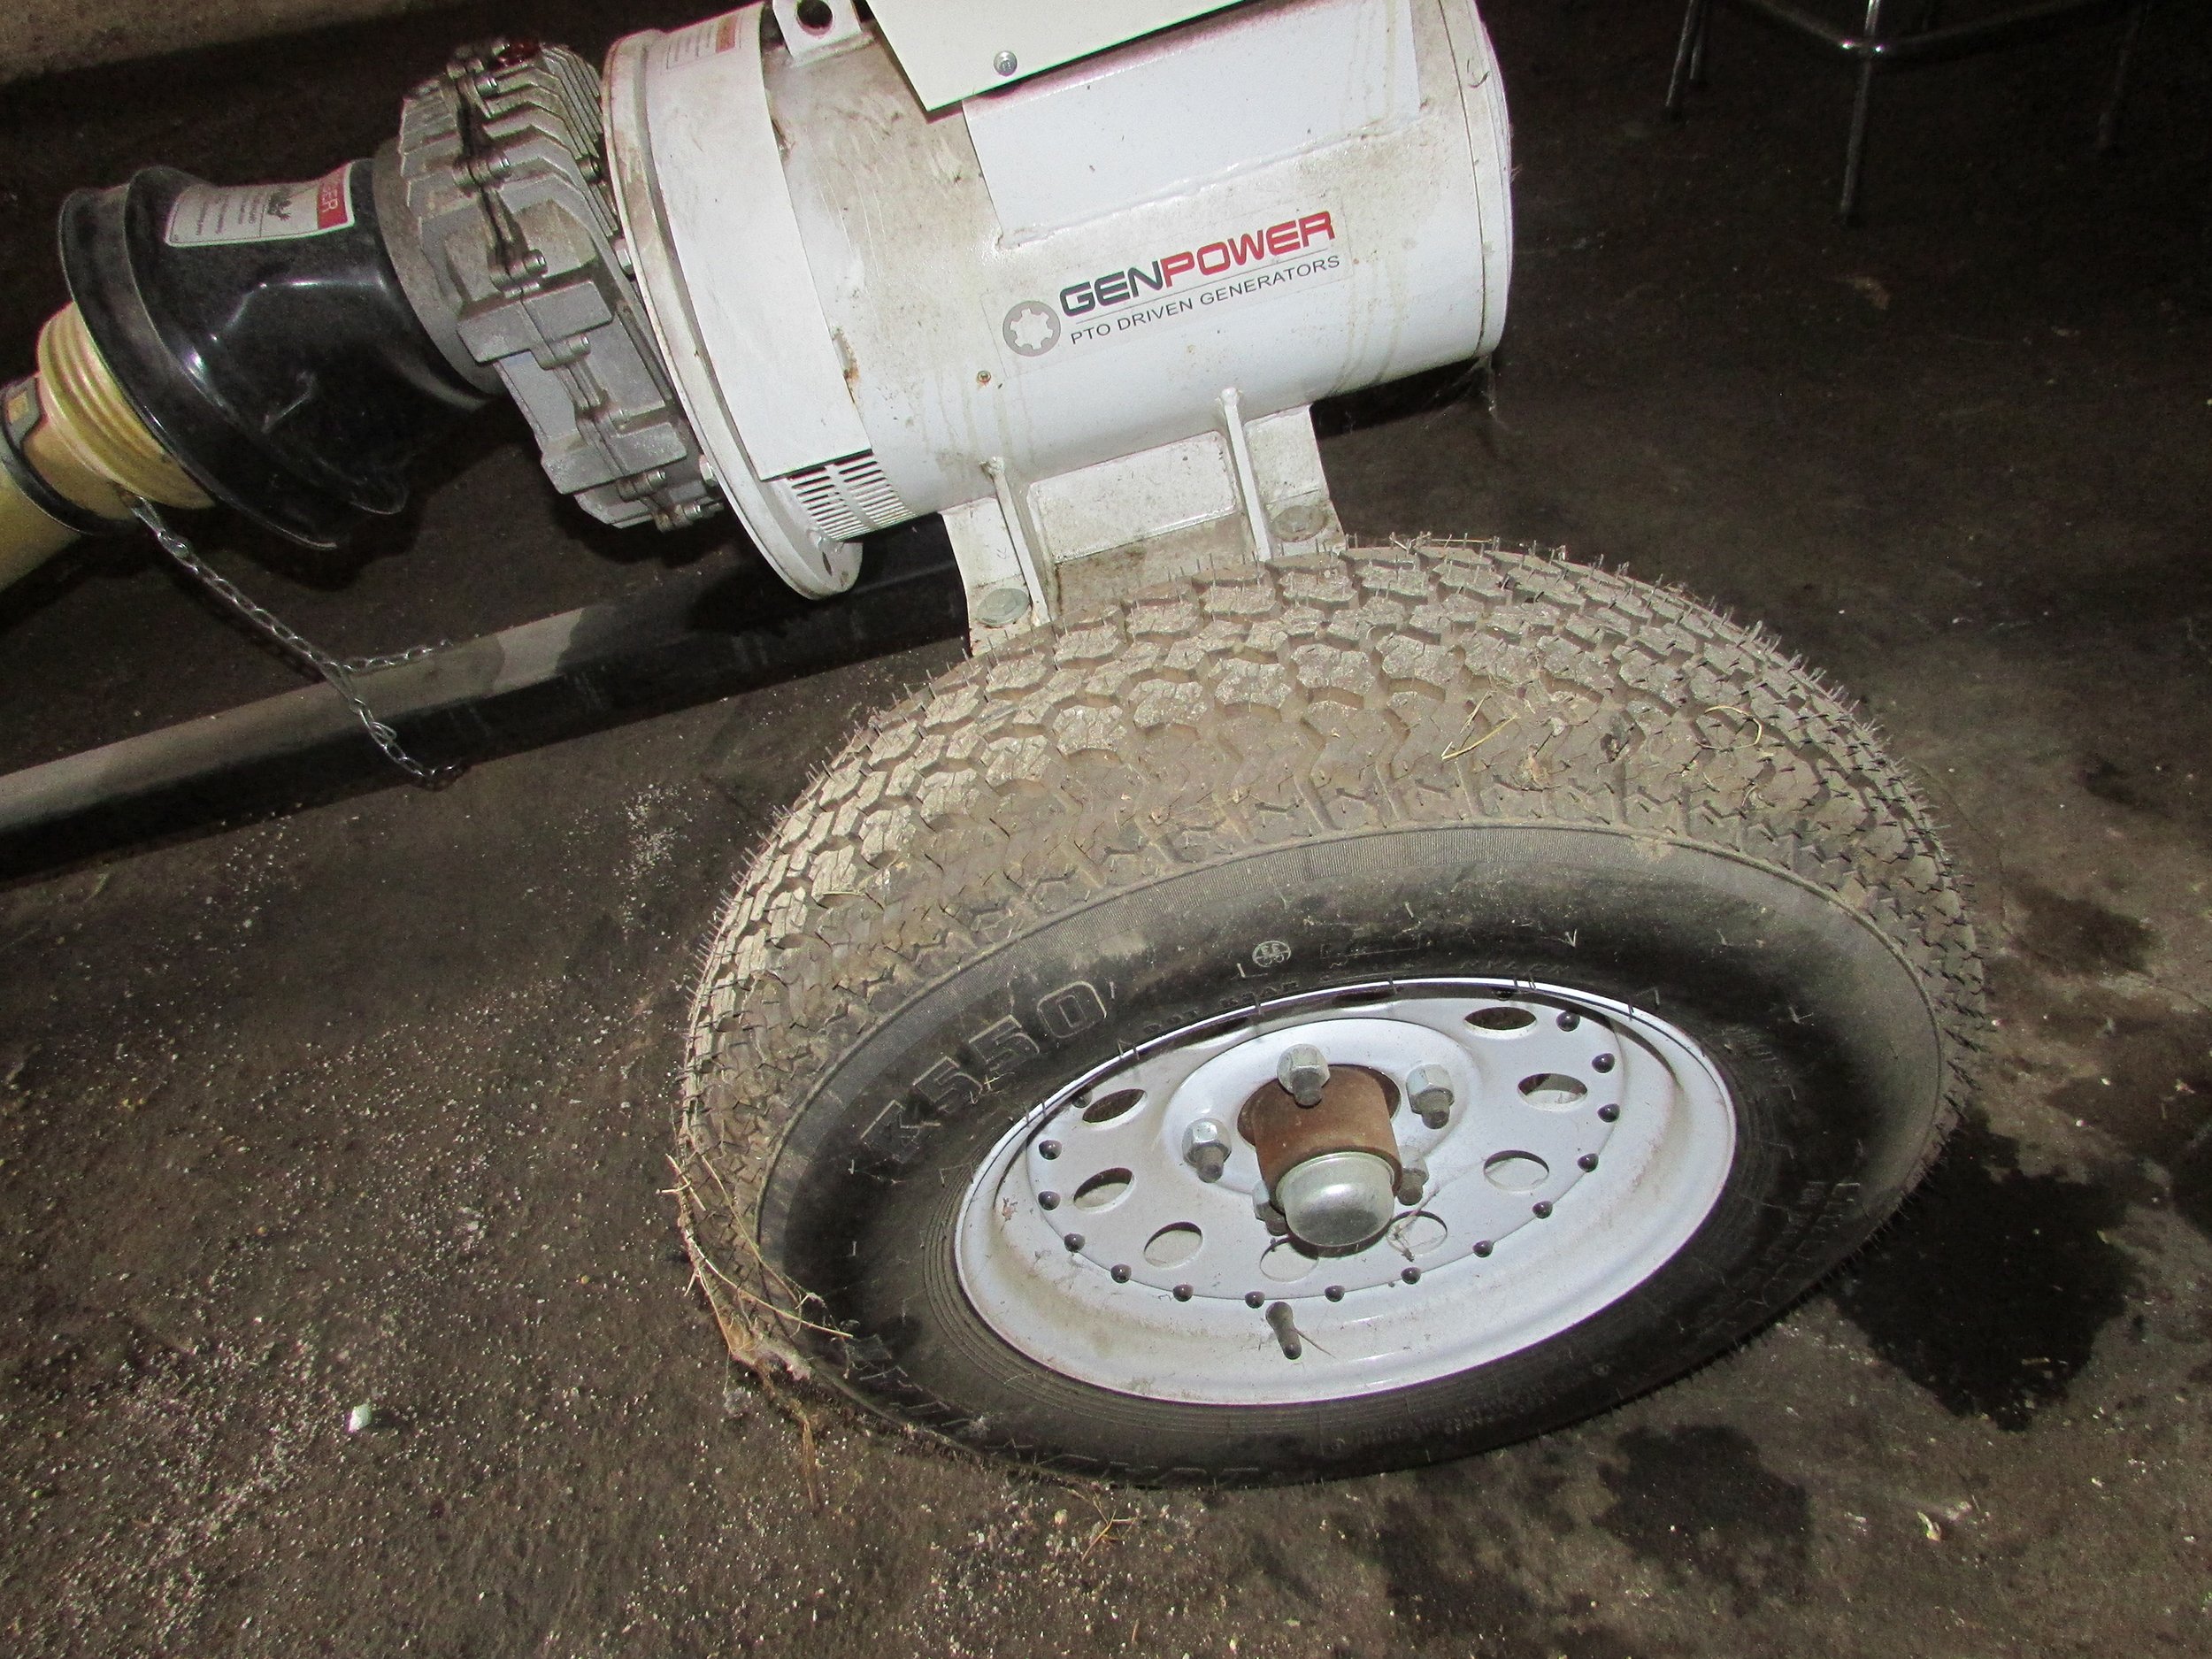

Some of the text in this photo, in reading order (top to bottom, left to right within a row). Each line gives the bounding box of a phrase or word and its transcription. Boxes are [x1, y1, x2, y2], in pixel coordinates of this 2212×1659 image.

[1060, 211, 1335, 317] GENPOWER
[1070, 255, 1340, 345] PTO DRIVEN GENERATORS
